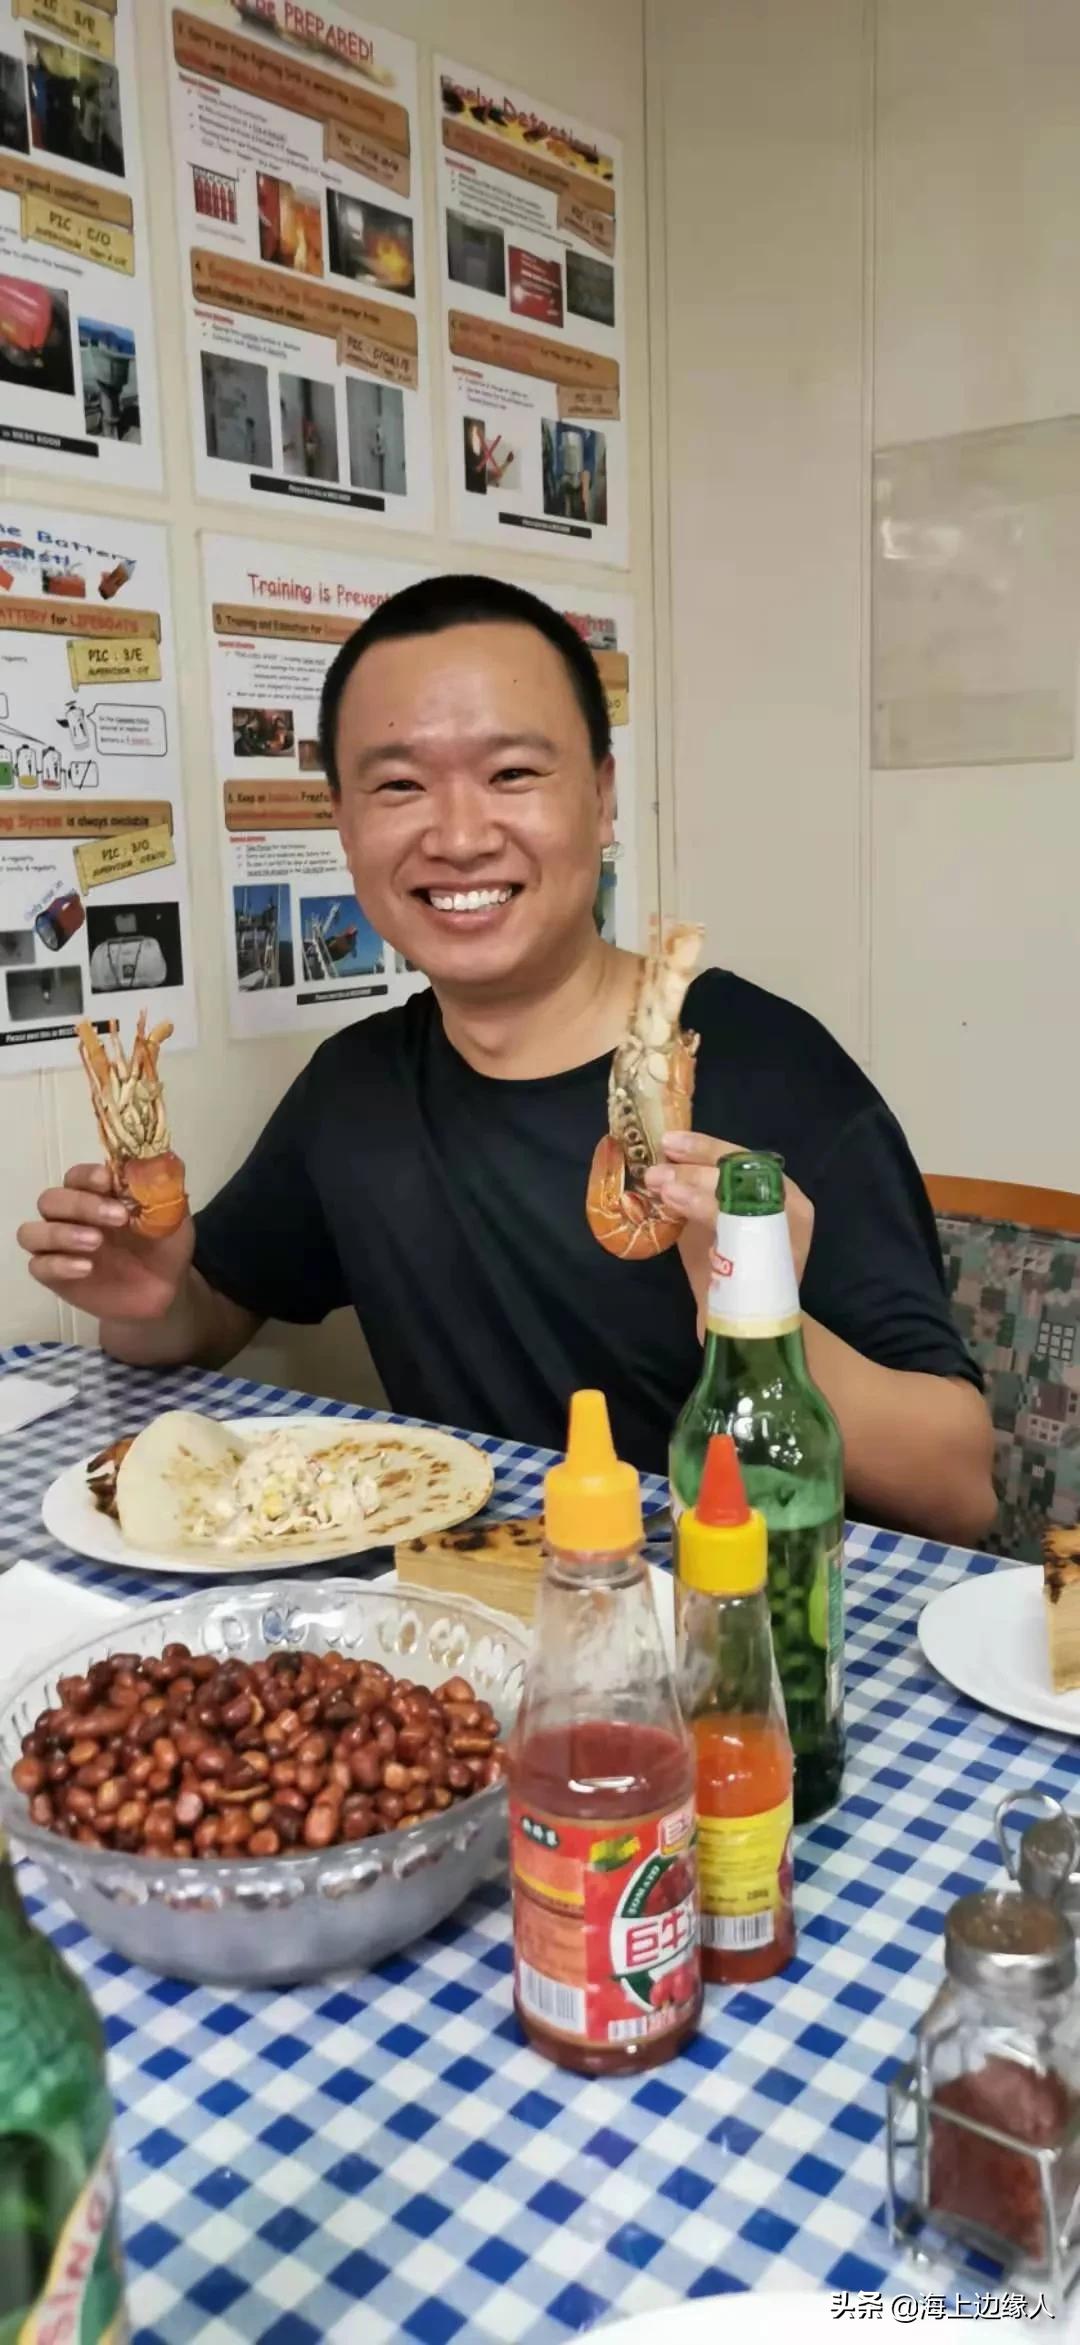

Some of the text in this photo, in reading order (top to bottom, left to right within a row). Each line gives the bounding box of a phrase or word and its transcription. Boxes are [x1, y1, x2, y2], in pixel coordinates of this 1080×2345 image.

[284, 2, 375, 65] PREPARED!
[248, 573, 312, 604] Training
[319, 583, 331, 602] is
[51, 614, 68, 626] for
[88, 648, 109, 662] PIC
[77, 816, 107, 831] always
[102, 848, 119, 860] PIC
[629, 1864, 660, 1913] TOMATO
